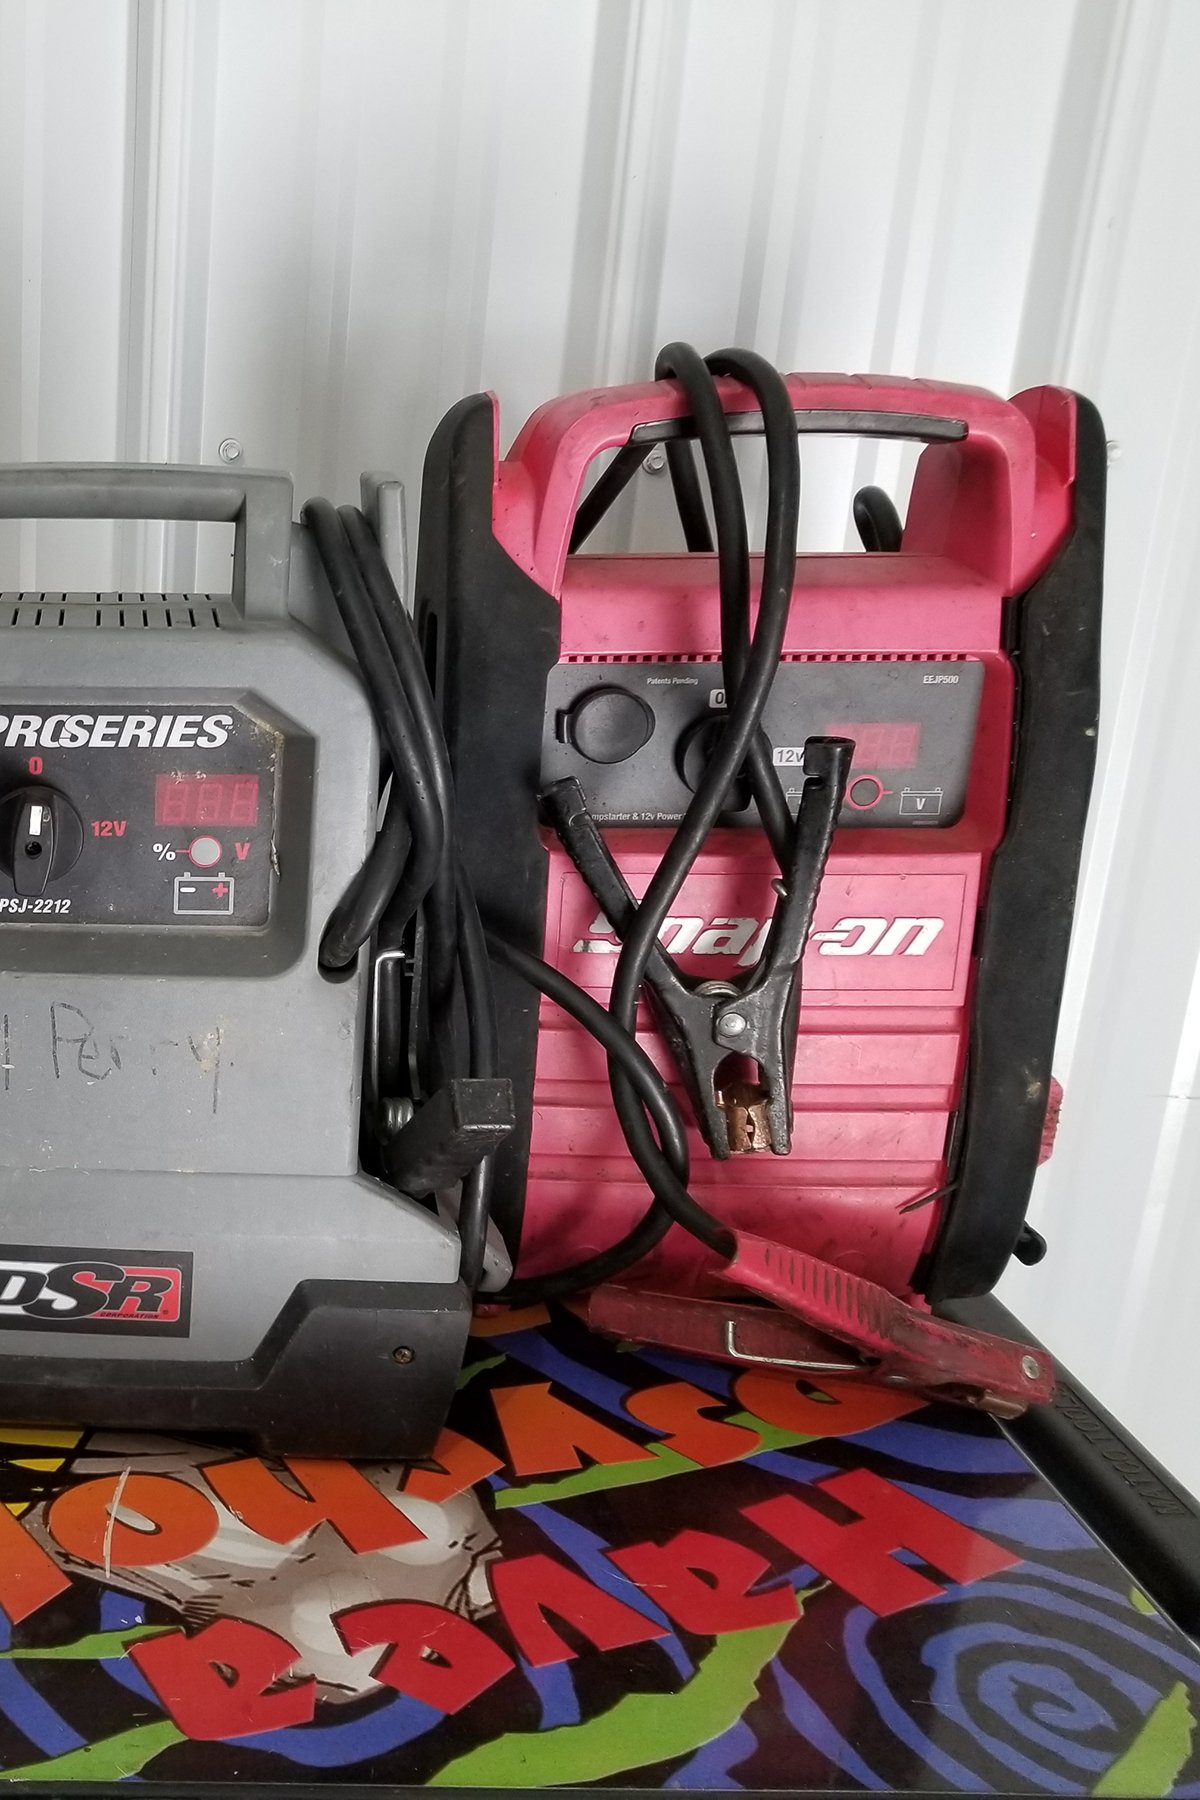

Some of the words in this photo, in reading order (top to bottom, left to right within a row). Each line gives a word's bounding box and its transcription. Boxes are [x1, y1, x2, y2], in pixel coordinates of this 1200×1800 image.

[647, 677, 671, 685] Patents
[922, 674, 959, 684] EEJP500
[916, 798, 926, 810] V
[632, 812, 639, 820] &
[657, 811, 682, 821] Power
[91, 820, 128, 838] 12V
[152, 843, 177, 861] %
[234, 842, 251, 861] V
